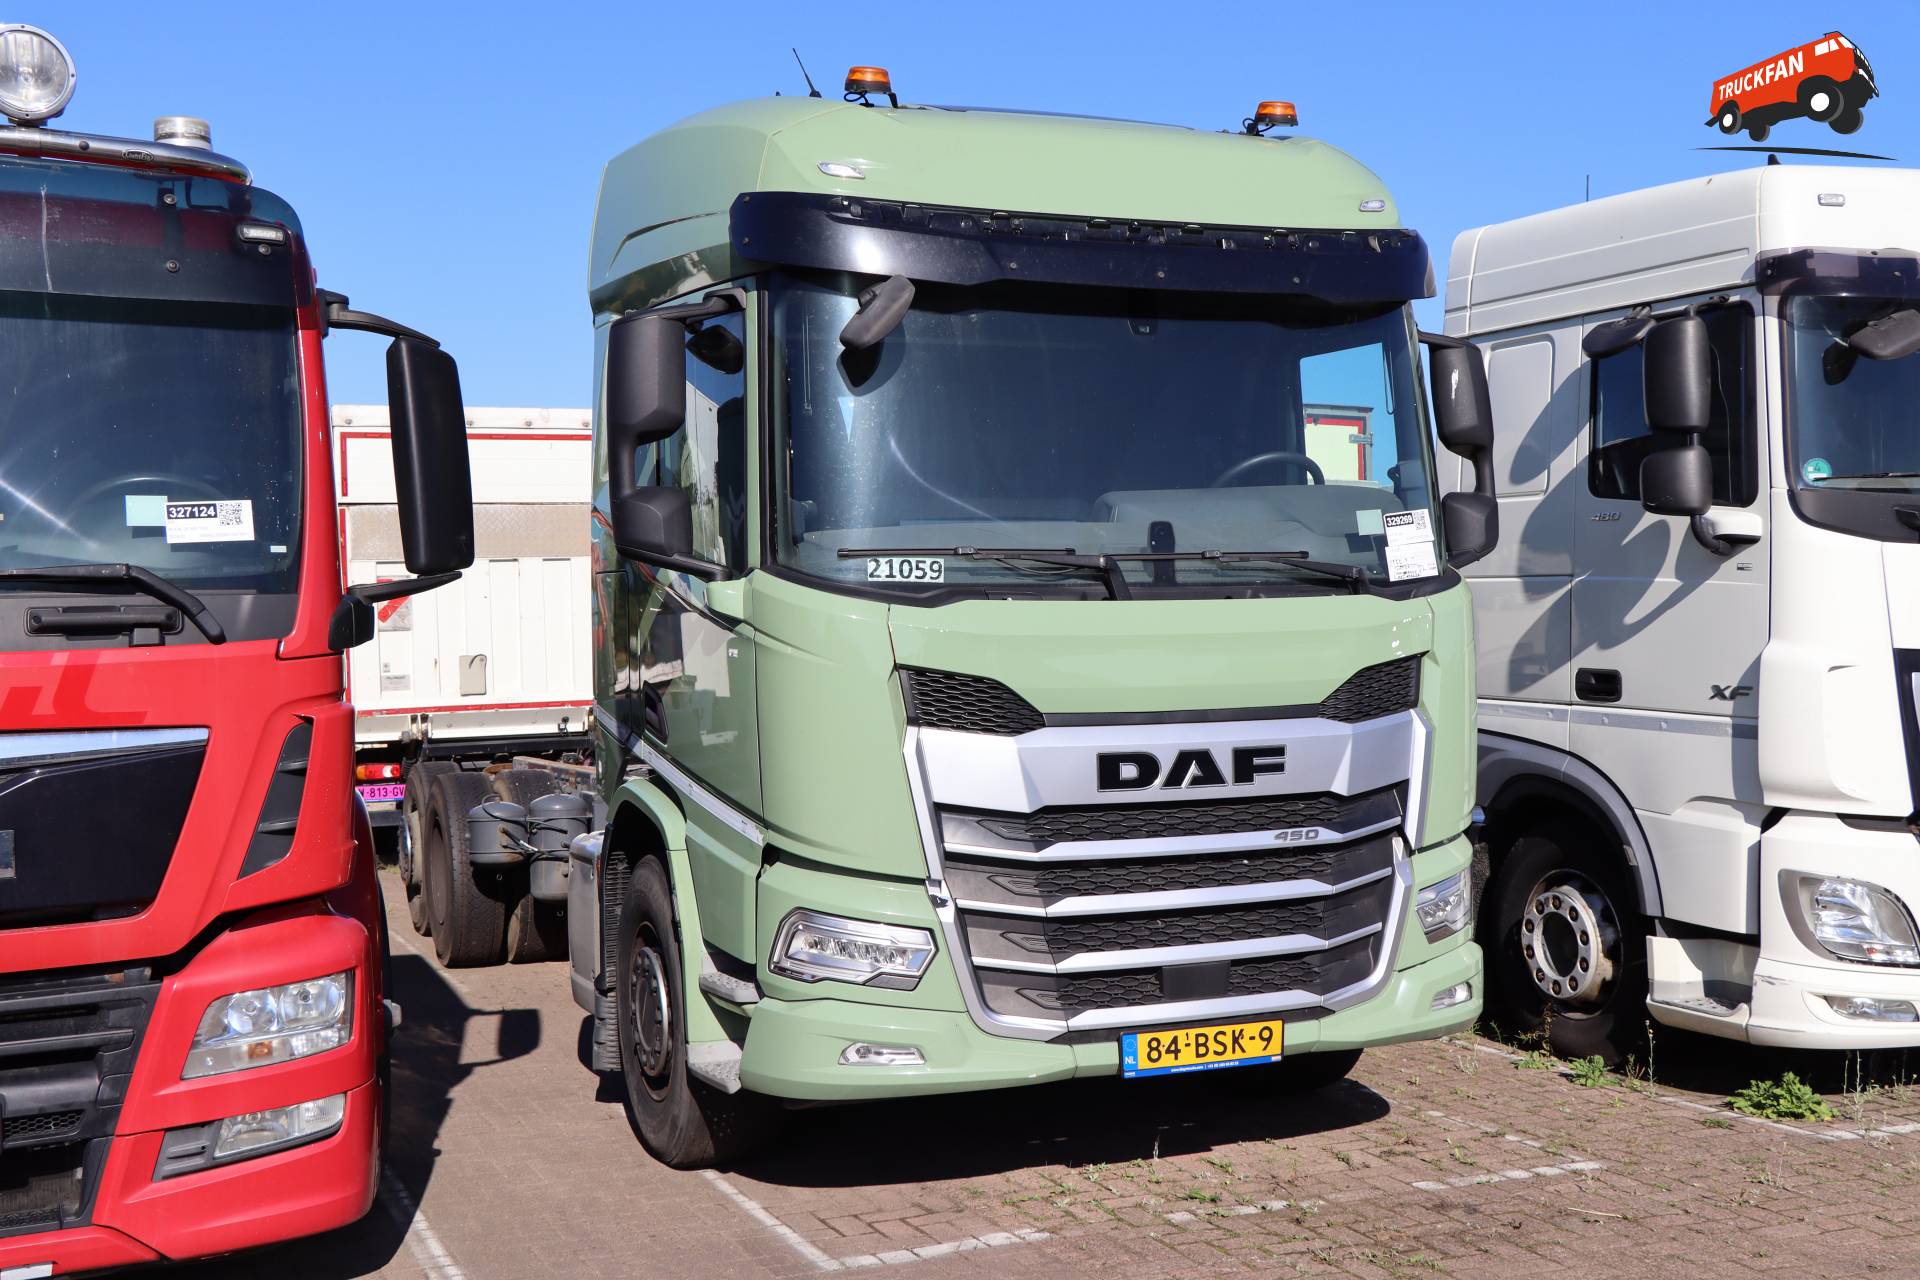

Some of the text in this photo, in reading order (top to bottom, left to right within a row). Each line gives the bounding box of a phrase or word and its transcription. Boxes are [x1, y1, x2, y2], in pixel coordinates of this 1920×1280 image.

[169, 506, 216, 518] 327124
[1386, 514, 1413, 526] 329269
[868, 558, 943, 580] 21059
[1709, 684, 1753, 700] XF
[1096, 744, 1287, 792] DAF
[1274, 827, 1319, 842] 450
[1146, 1026, 1274, 1063] 84-BSK-9
[1124, 1055, 1136, 1065] NL
